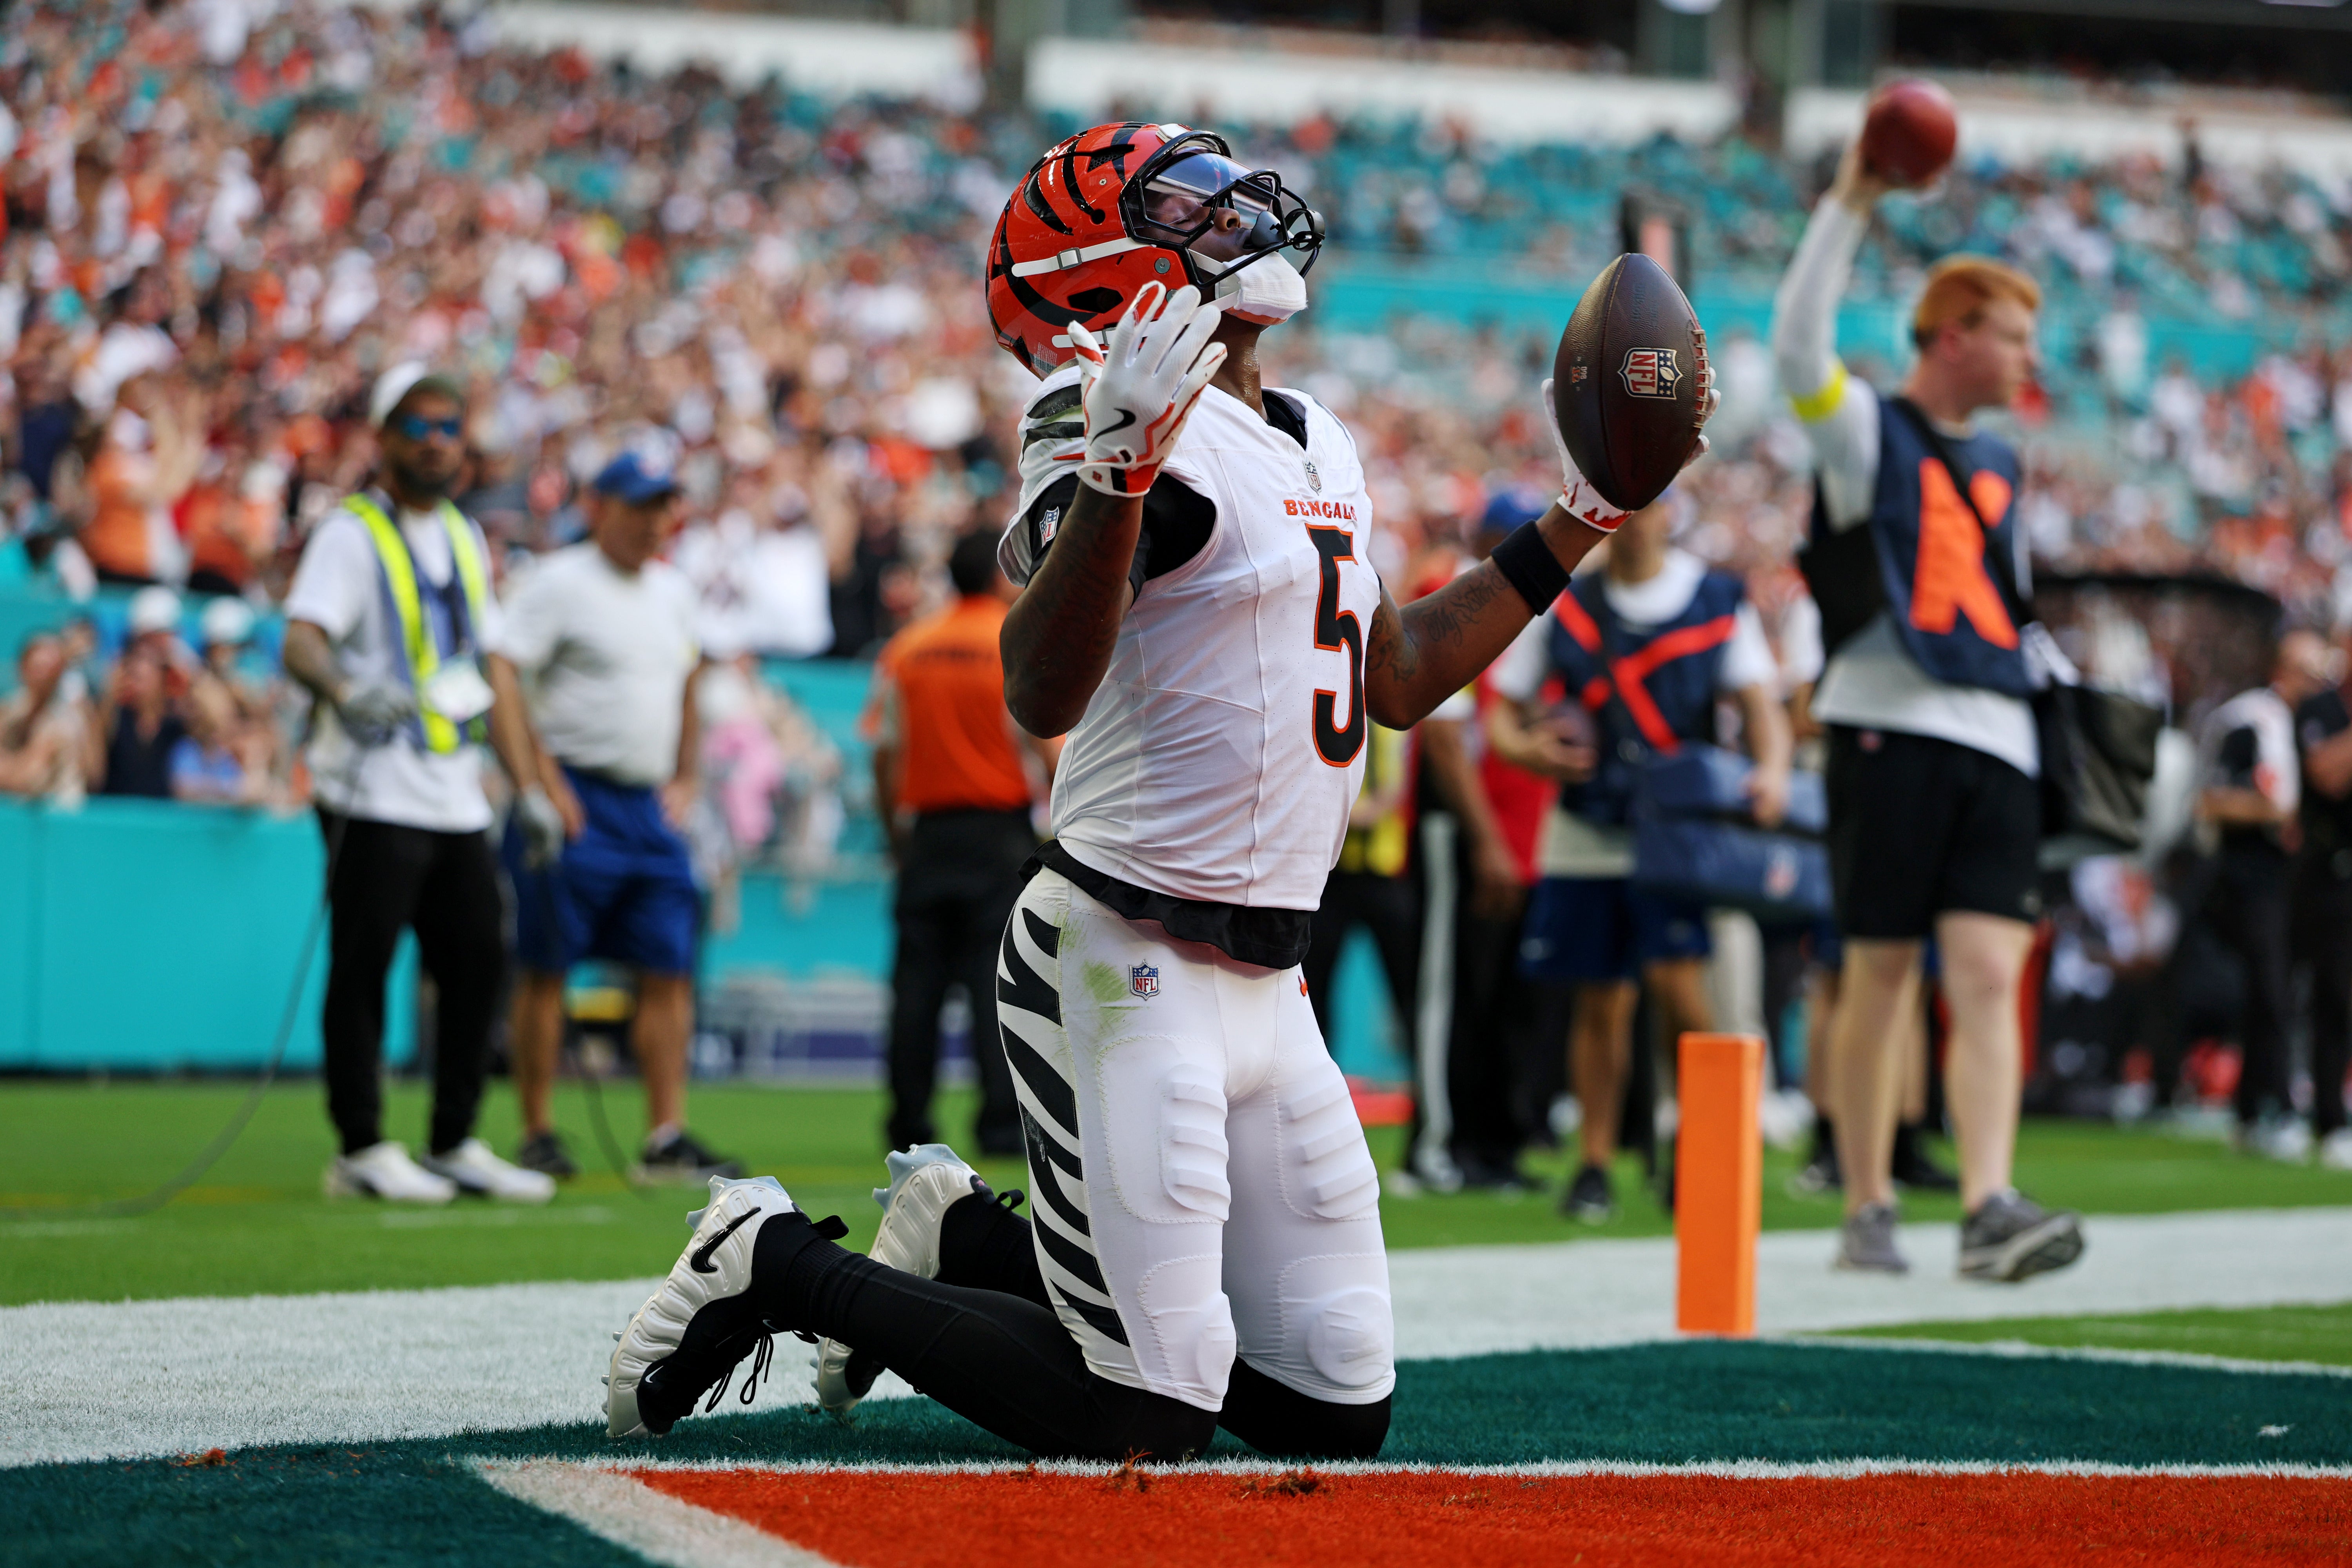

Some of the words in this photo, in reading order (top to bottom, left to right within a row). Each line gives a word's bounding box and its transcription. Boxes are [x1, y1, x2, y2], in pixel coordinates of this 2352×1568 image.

[1628, 353, 1655, 392] NFL
[1309, 474, 1320, 487] NFL
[1283, 499, 1357, 521] BENGALS
[1305, 523, 1366, 767] 5
[1135, 978, 1156, 992] NFL
